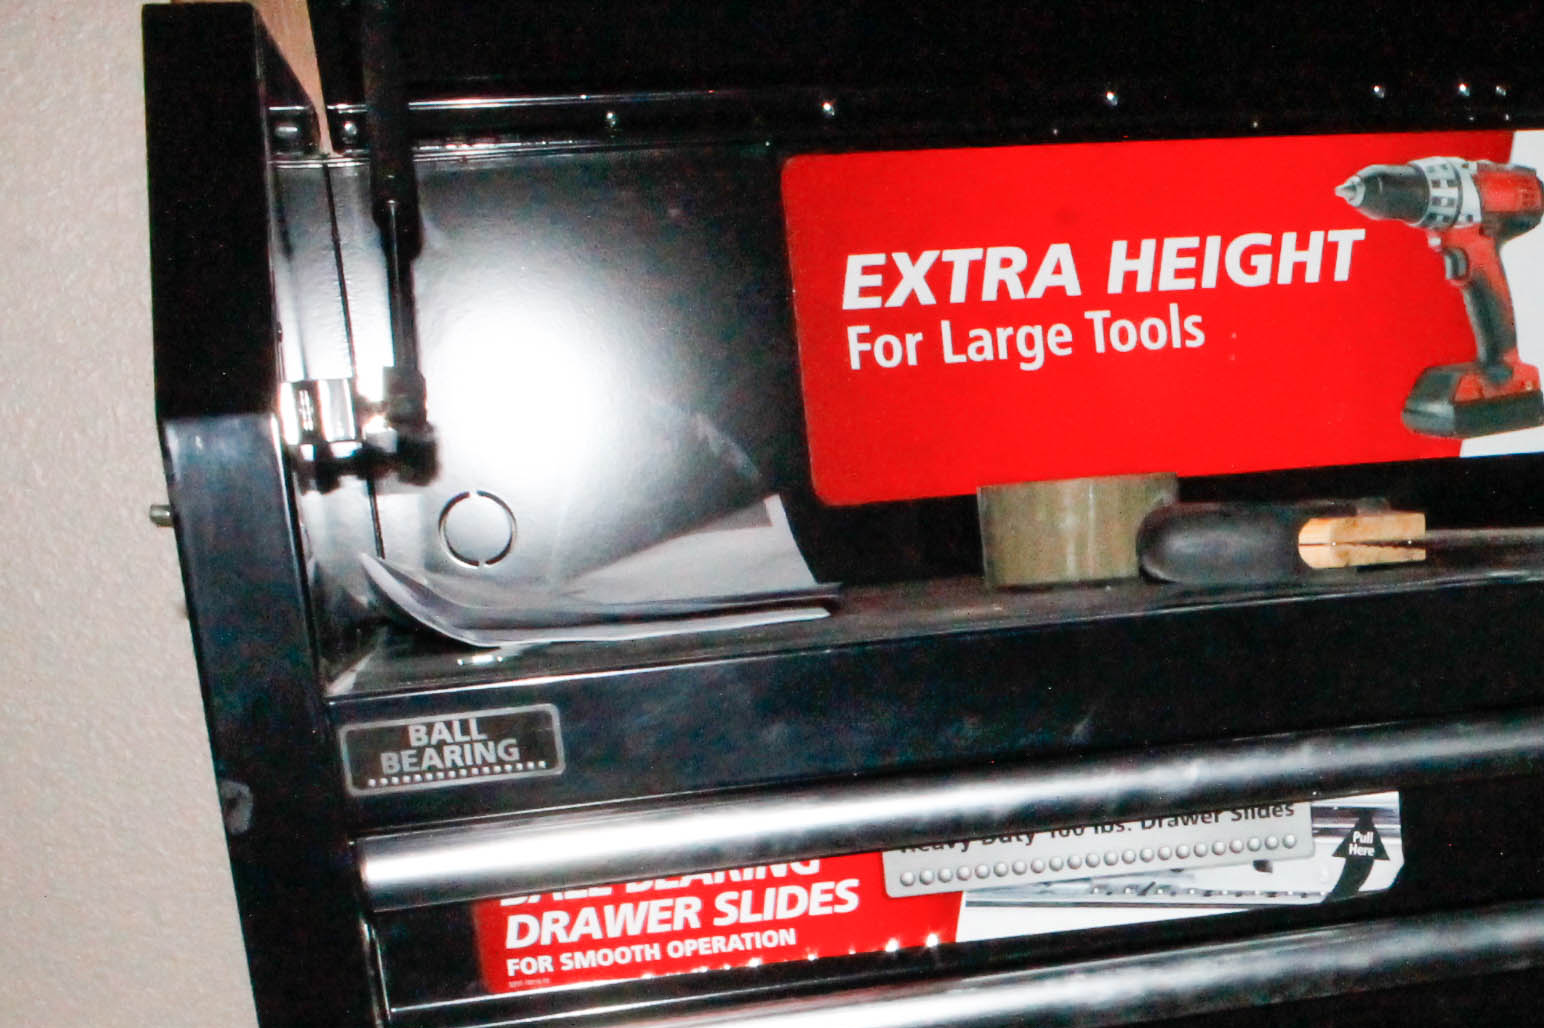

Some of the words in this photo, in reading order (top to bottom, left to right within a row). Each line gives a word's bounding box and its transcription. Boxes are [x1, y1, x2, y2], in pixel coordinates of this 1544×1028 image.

[842, 243, 1081, 310] EXTRA
[1107, 228, 1365, 294] HEIGHT
[847, 324, 923, 370] For
[940, 320, 1073, 371] Large
[1084, 303, 1205, 353] Tools
[408, 718, 488, 747] BALL
[380, 738, 520, 775] BEARING
[1348, 842, 1375, 857] Here
[1353, 830, 1374, 844] Pull
[506, 896, 702, 949] DRAWER
[713, 878, 860, 926] SLIDES
[506, 955, 554, 976] FOR
[561, 942, 661, 971] SMOOTH
[667, 928, 797, 958] OPERATION
